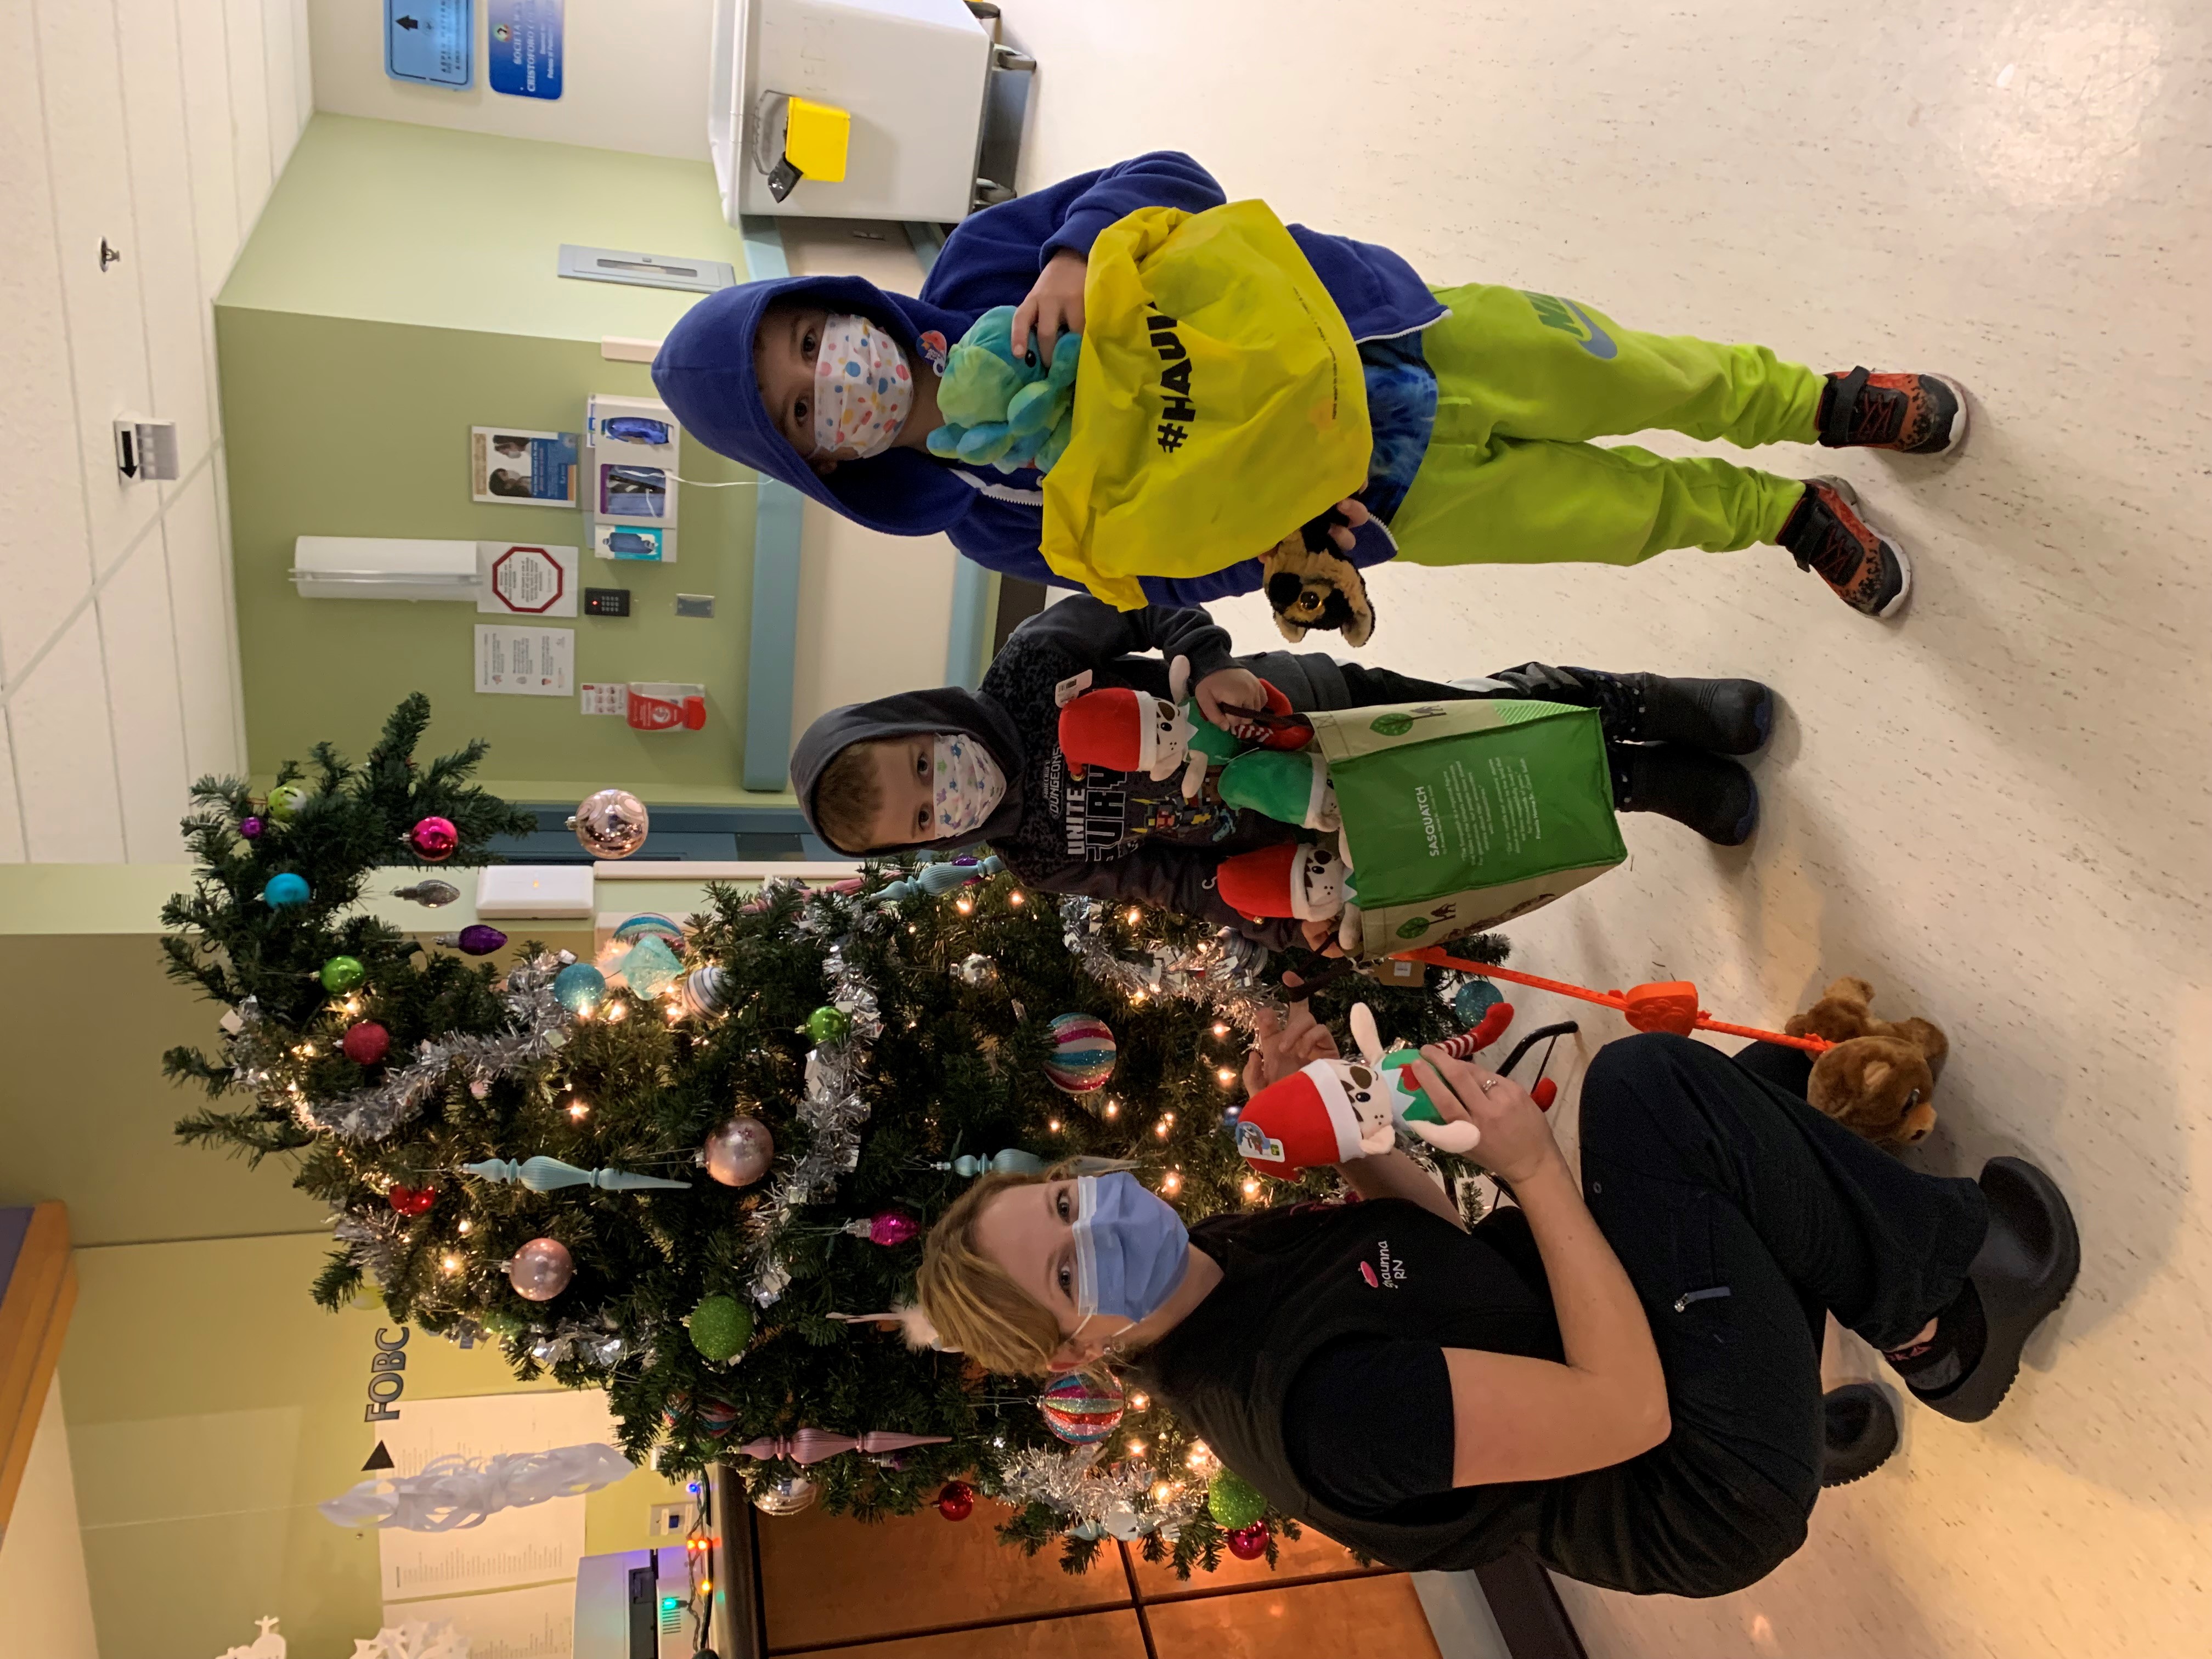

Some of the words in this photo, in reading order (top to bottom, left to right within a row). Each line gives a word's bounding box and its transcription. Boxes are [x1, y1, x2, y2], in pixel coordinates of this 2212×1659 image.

[1042, 760, 1051, 798] MINECRAFT
[1049, 747, 1062, 814] DUNGEONS
[1066, 788, 1085, 854] UNITE
[1415, 787, 1440, 856] SASQUATCH
[1392, 1260, 1407, 1279] RN
[364, 1327, 410, 1423] FOBC
